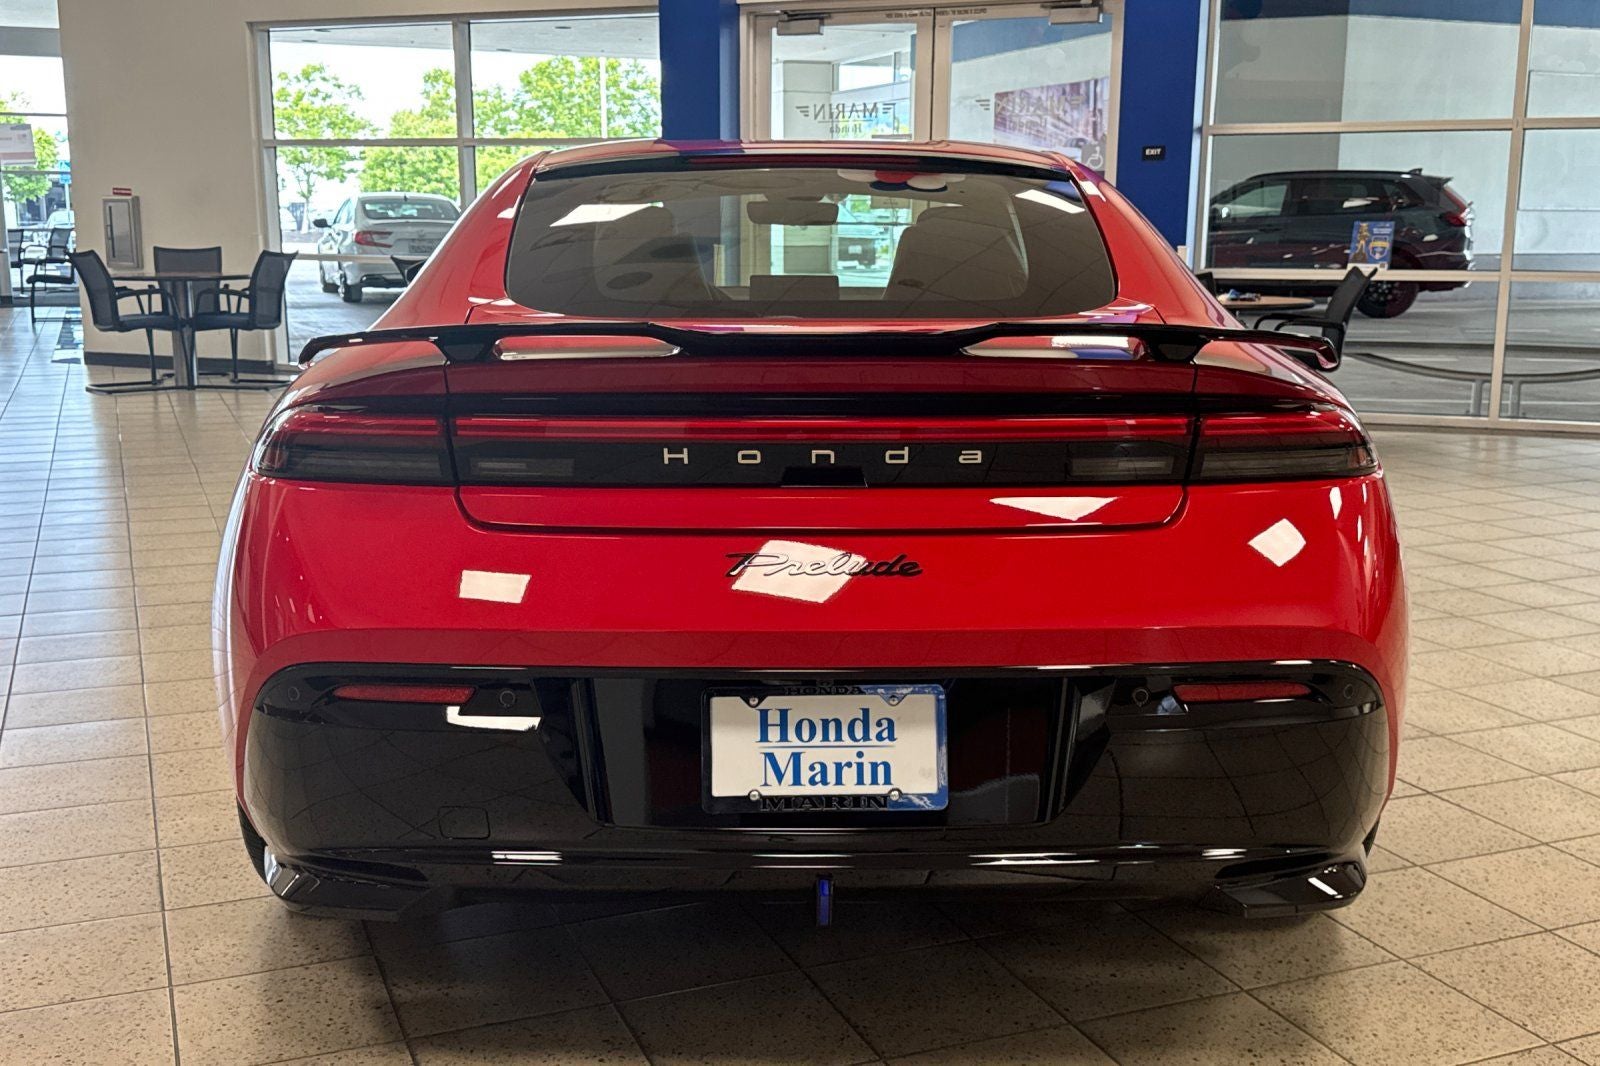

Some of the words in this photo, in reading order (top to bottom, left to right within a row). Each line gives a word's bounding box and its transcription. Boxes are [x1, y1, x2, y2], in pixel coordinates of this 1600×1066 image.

[1145, 148, 1162, 156] EXIT
[725, 552, 923, 578] Prelude
[785, 686, 867, 695] HONDA
[755, 707, 897, 744] Honda
[760, 750, 894, 787] Marin
[759, 795, 889, 811] MARIN
